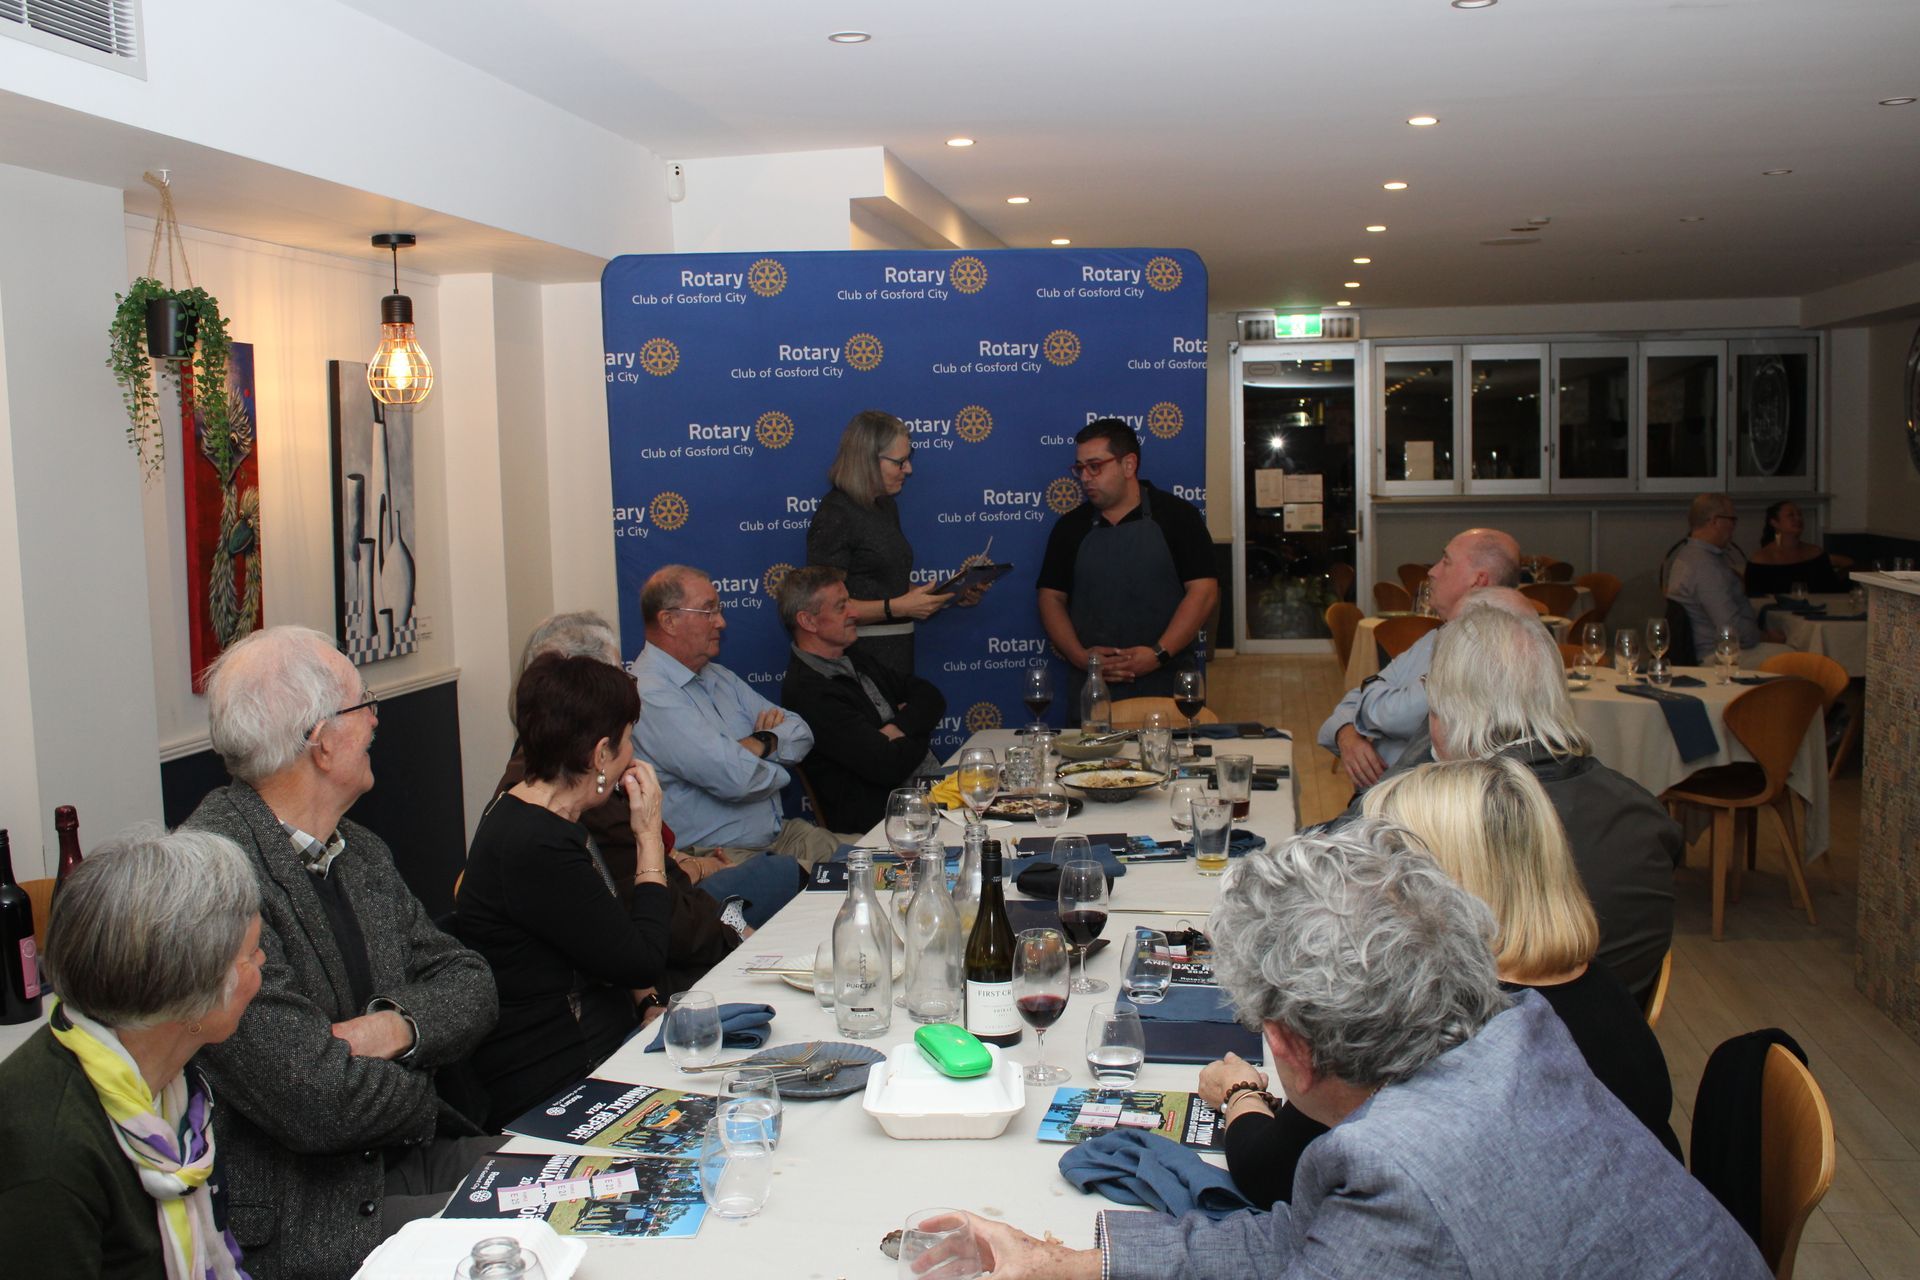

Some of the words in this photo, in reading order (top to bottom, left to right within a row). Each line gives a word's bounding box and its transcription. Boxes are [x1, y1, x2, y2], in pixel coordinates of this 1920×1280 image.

[682, 271, 743, 289] Rotary
[885, 267, 945, 285] Rotary
[1083, 266, 1140, 284] Rotary
[632, 295, 657, 304] Club
[661, 294, 673, 304] of
[677, 293, 721, 304] Gosford
[725, 292, 746, 304] City
[838, 290, 862, 300] Club
[866, 290, 877, 299] of
[881, 289, 924, 299] Gosford
[928, 289, 948, 300] City
[1037, 288, 1060, 297] Club
[1064, 288, 1075, 297] of
[1079, 287, 1120, 297] Gosford
[1124, 287, 1144, 298] City
[779, 345, 840, 363] Rotary
[980, 341, 1038, 358] Rotary
[933, 363, 957, 373] Club
[960, 363, 972, 372] of
[975, 362, 1017, 372] Gosford
[1021, 362, 1041, 373] City
[1128, 360, 1151, 369] Club
[1154, 359, 1165, 369] of
[618, 372, 638, 384] City
[731, 368, 756, 378] Club
[760, 368, 771, 377] of
[775, 366, 818, 377] Gosford
[823, 366, 843, 378] City
[689, 424, 750, 441] Rotary
[934, 438, 954, 450] City
[1041, 435, 1064, 445] Club
[1067, 436, 1076, 444] o
[641, 448, 666, 458] Club
[670, 447, 681, 457] of
[685, 446, 729, 456] Gosford
[733, 445, 754, 456] City
[787, 496, 821, 512] Rot
[984, 489, 1041, 507] Rotary
[938, 513, 961, 523] Club
[965, 512, 976, 522] of
[979, 511, 1020, 521] Gosford
[1024, 510, 1044, 522] City
[740, 521, 764, 531] Club
[767, 520, 779, 530] of
[628, 527, 648, 538] City
[712, 578, 758, 594] otary
[742, 598, 762, 609] City
[989, 637, 1045, 654] Rotary
[944, 661, 966, 671] Club
[970, 660, 981, 670] of
[984, 658, 1025, 669] Gosford
[1029, 658, 1048, 669] City
[748, 672, 772, 682] Club
[945, 734, 964, 745] City
[567, 1111, 613, 1139] REPORT
[480, 1172, 500, 1189] Rotary
